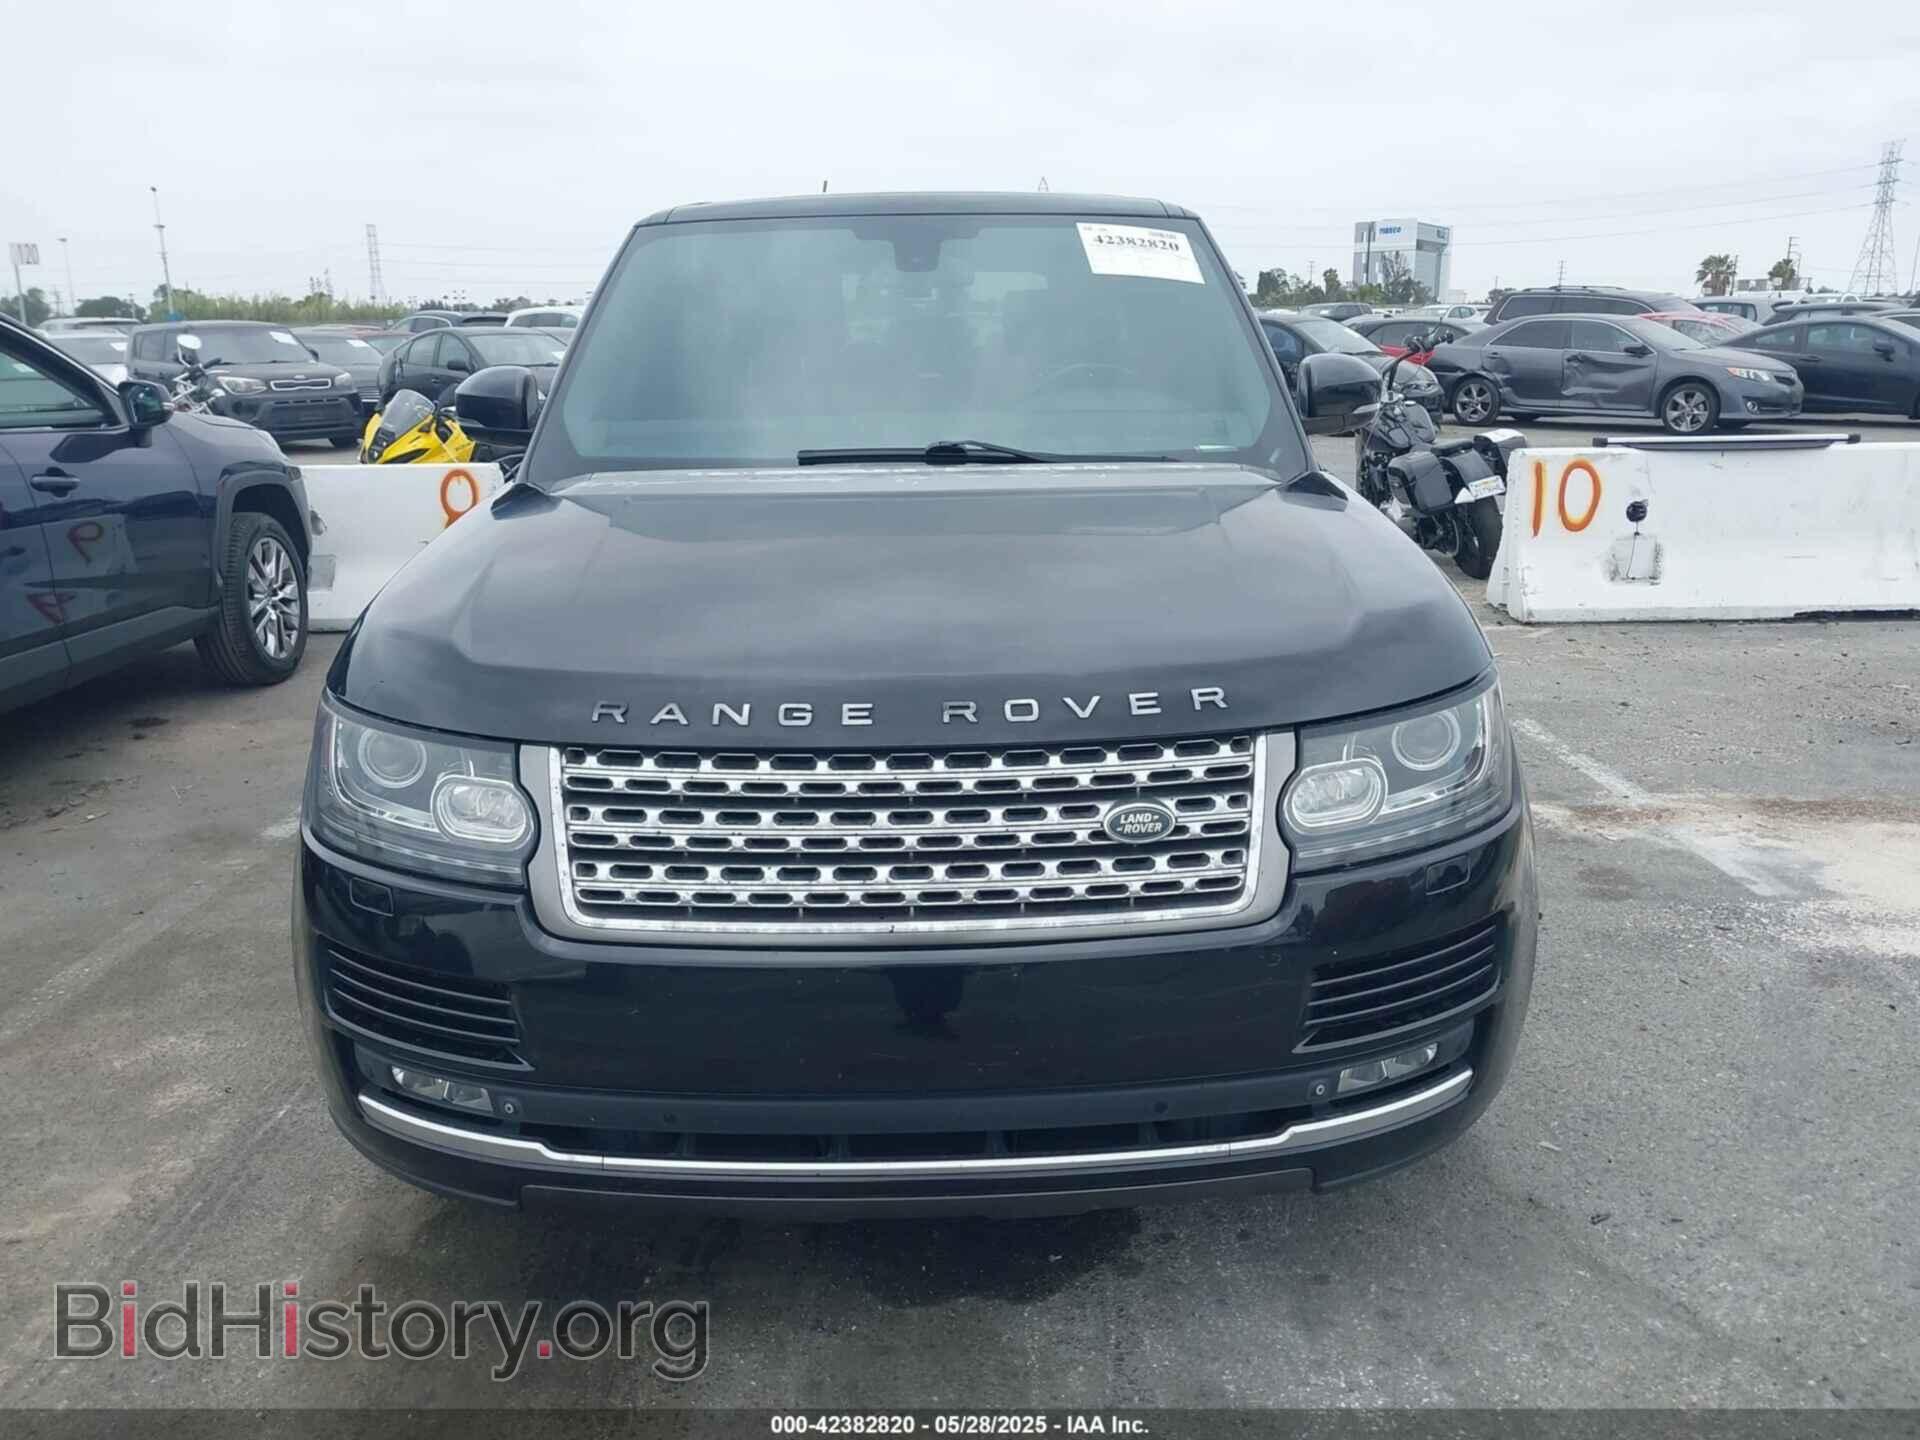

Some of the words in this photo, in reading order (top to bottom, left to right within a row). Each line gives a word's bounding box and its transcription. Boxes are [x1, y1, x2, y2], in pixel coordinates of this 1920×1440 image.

[1094, 234, 1180, 252] 42382820
[1532, 459, 1601, 537] 10
[591, 702, 874, 726] RANGE
[942, 686, 1229, 723] ROVER
